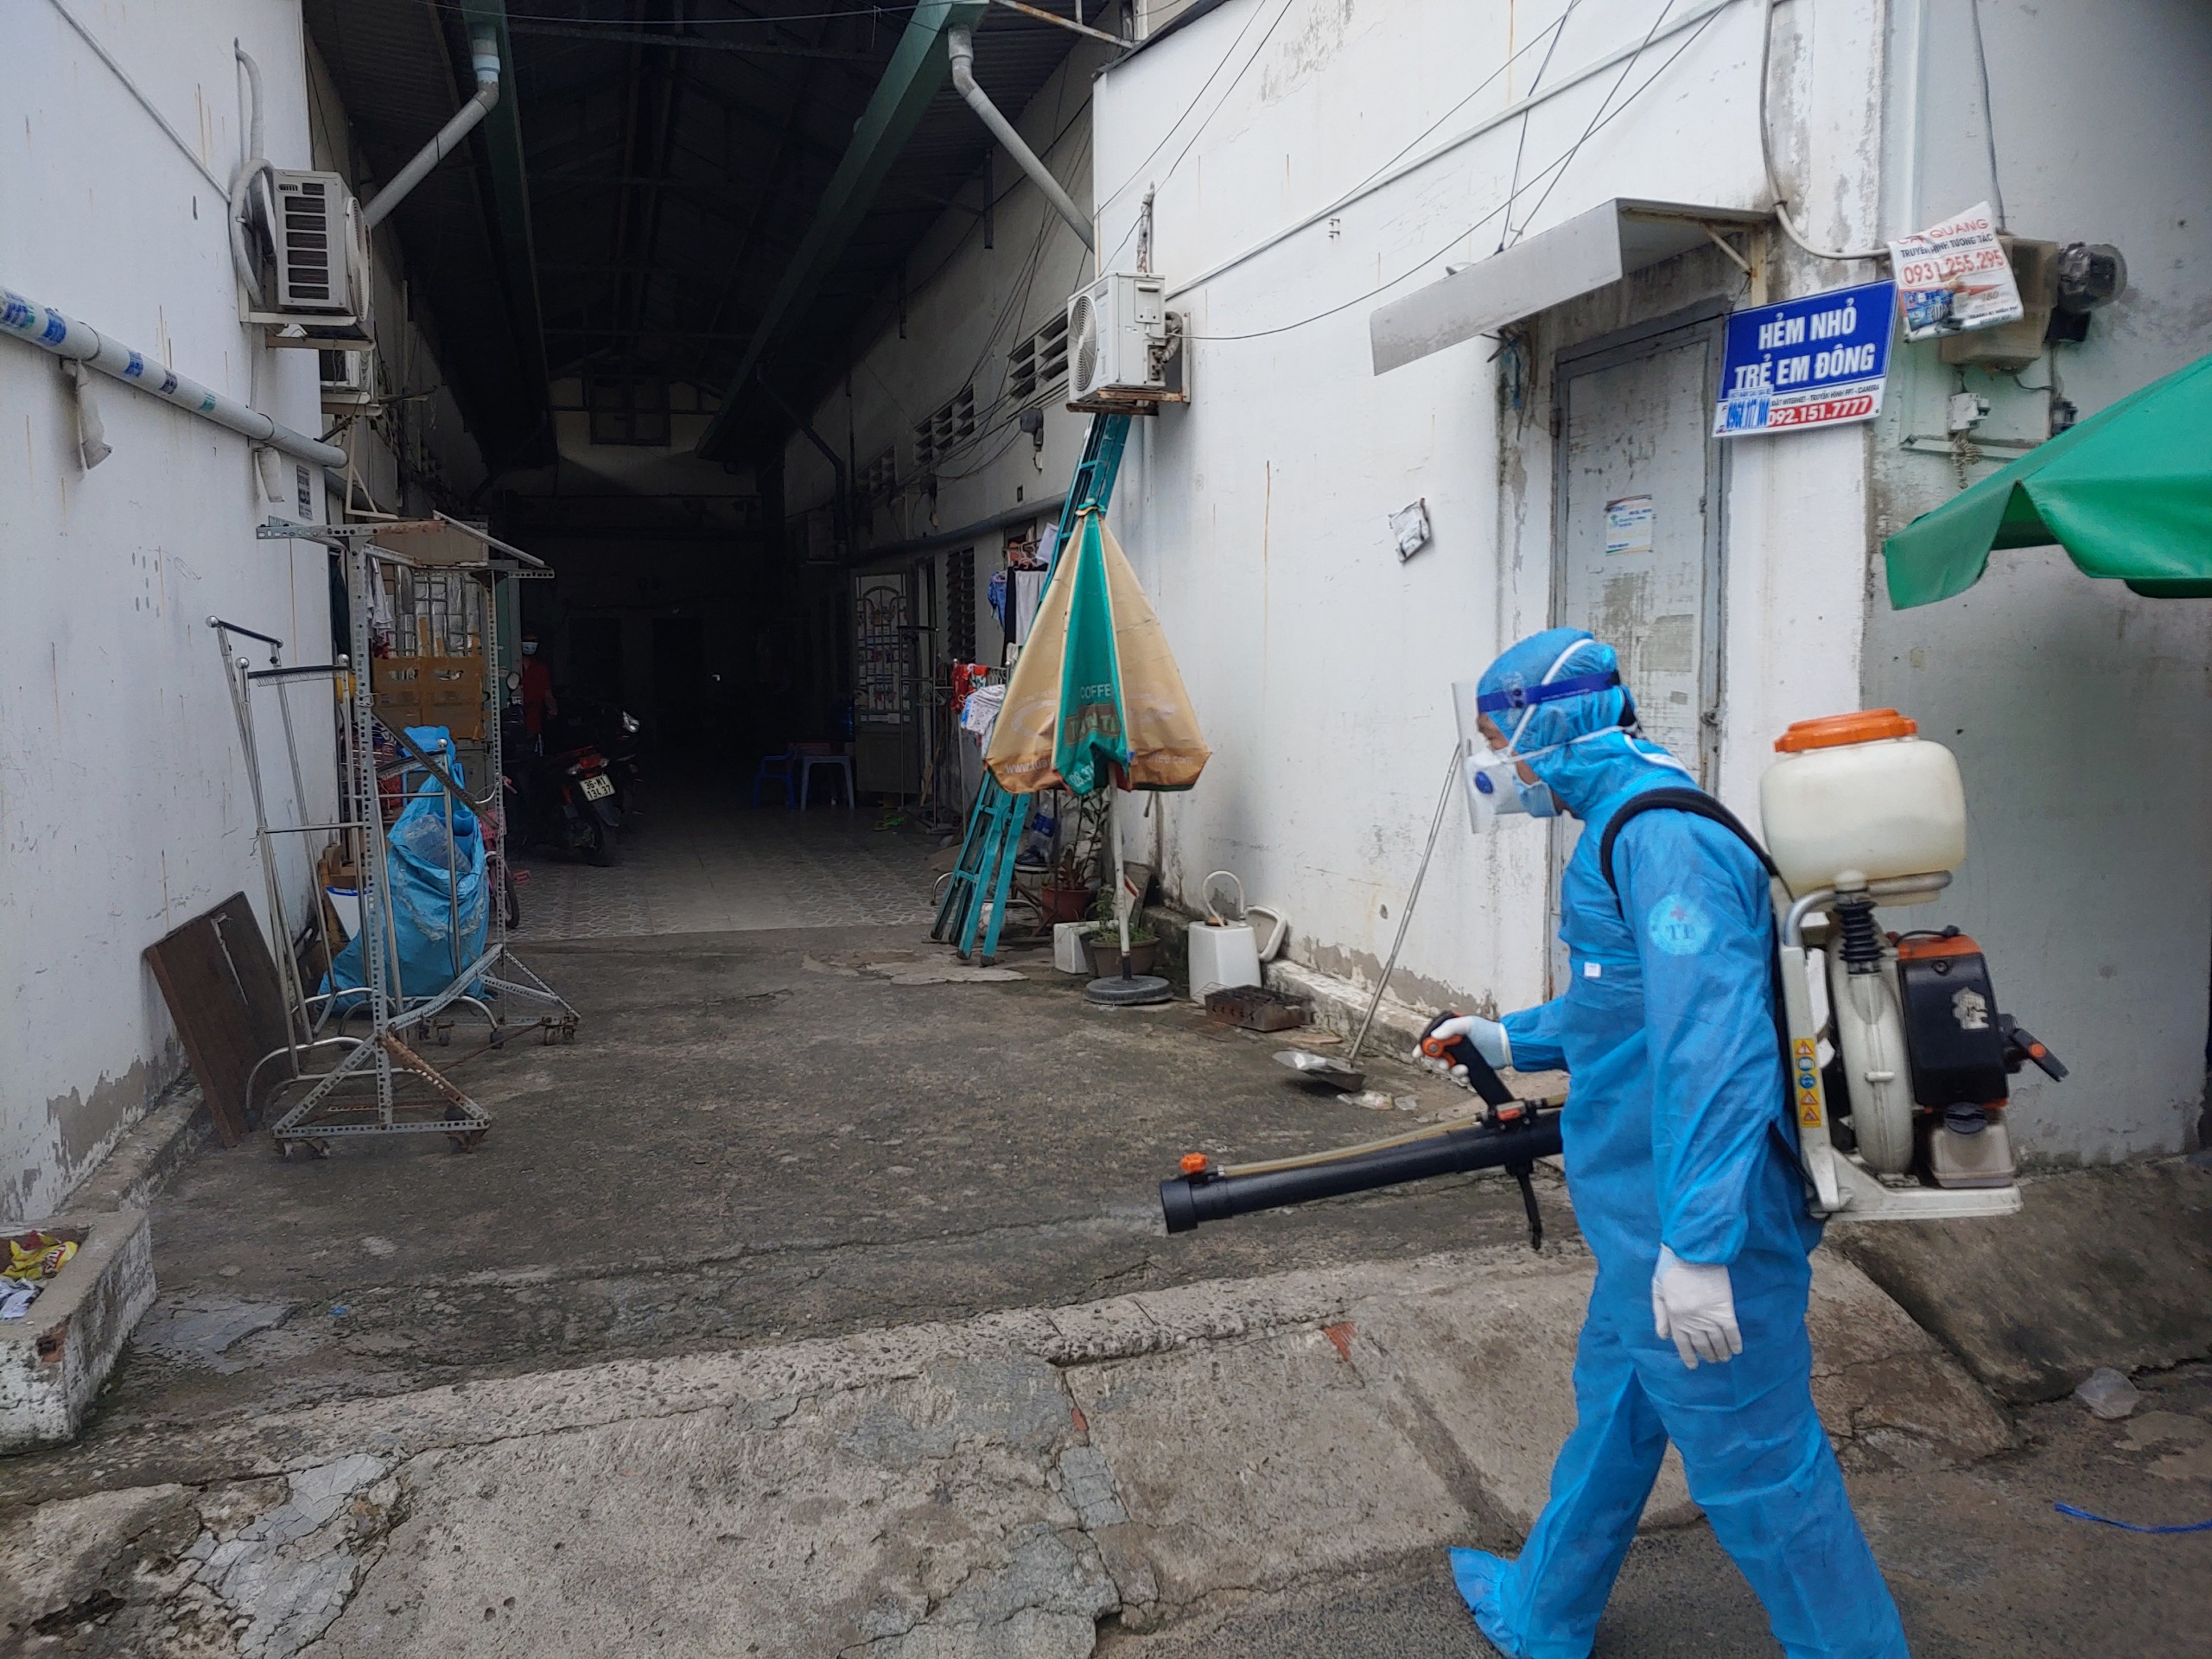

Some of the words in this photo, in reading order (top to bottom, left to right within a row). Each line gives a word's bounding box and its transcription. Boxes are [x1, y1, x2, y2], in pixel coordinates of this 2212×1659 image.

[1929, 218, 1989, 238] QUANG
[1758, 312, 1806, 351] HẺM
[1809, 297, 1857, 341] NHỎ
[1734, 353, 1773, 389] TRẺ
[1776, 354, 1811, 385] EM
[1814, 343, 1876, 379] ĐÔNG
